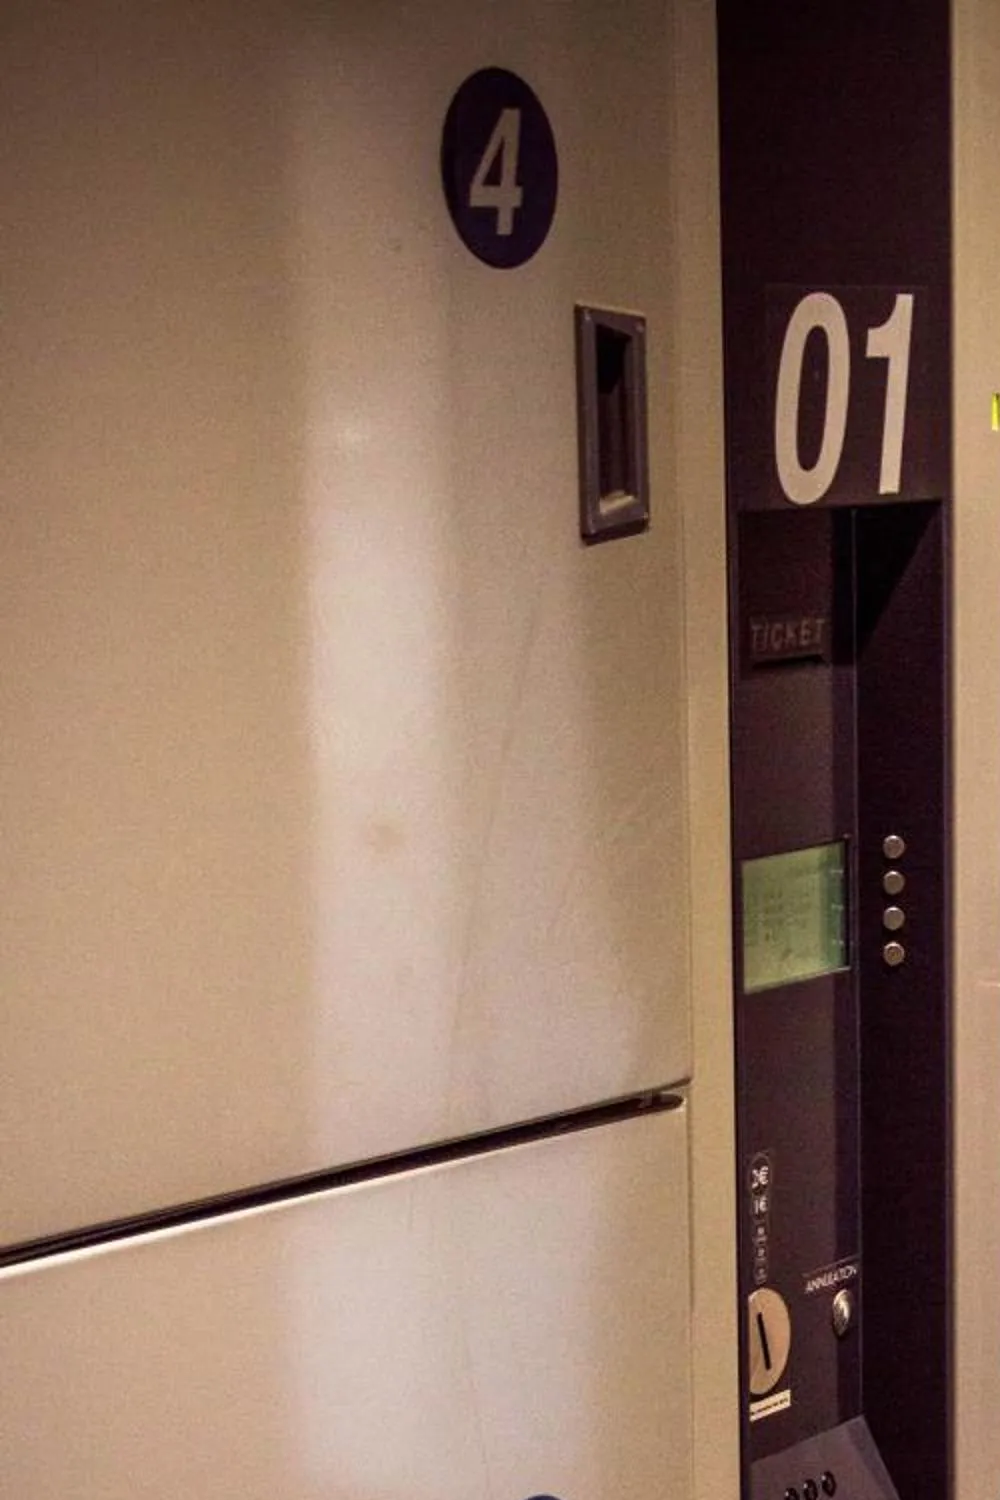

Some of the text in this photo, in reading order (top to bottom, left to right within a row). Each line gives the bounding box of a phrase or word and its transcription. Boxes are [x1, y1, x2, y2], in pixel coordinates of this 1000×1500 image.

[469, 107, 523, 235] 4
[775, 292, 914, 505] 01
[749, 618, 825, 651] TICKET
